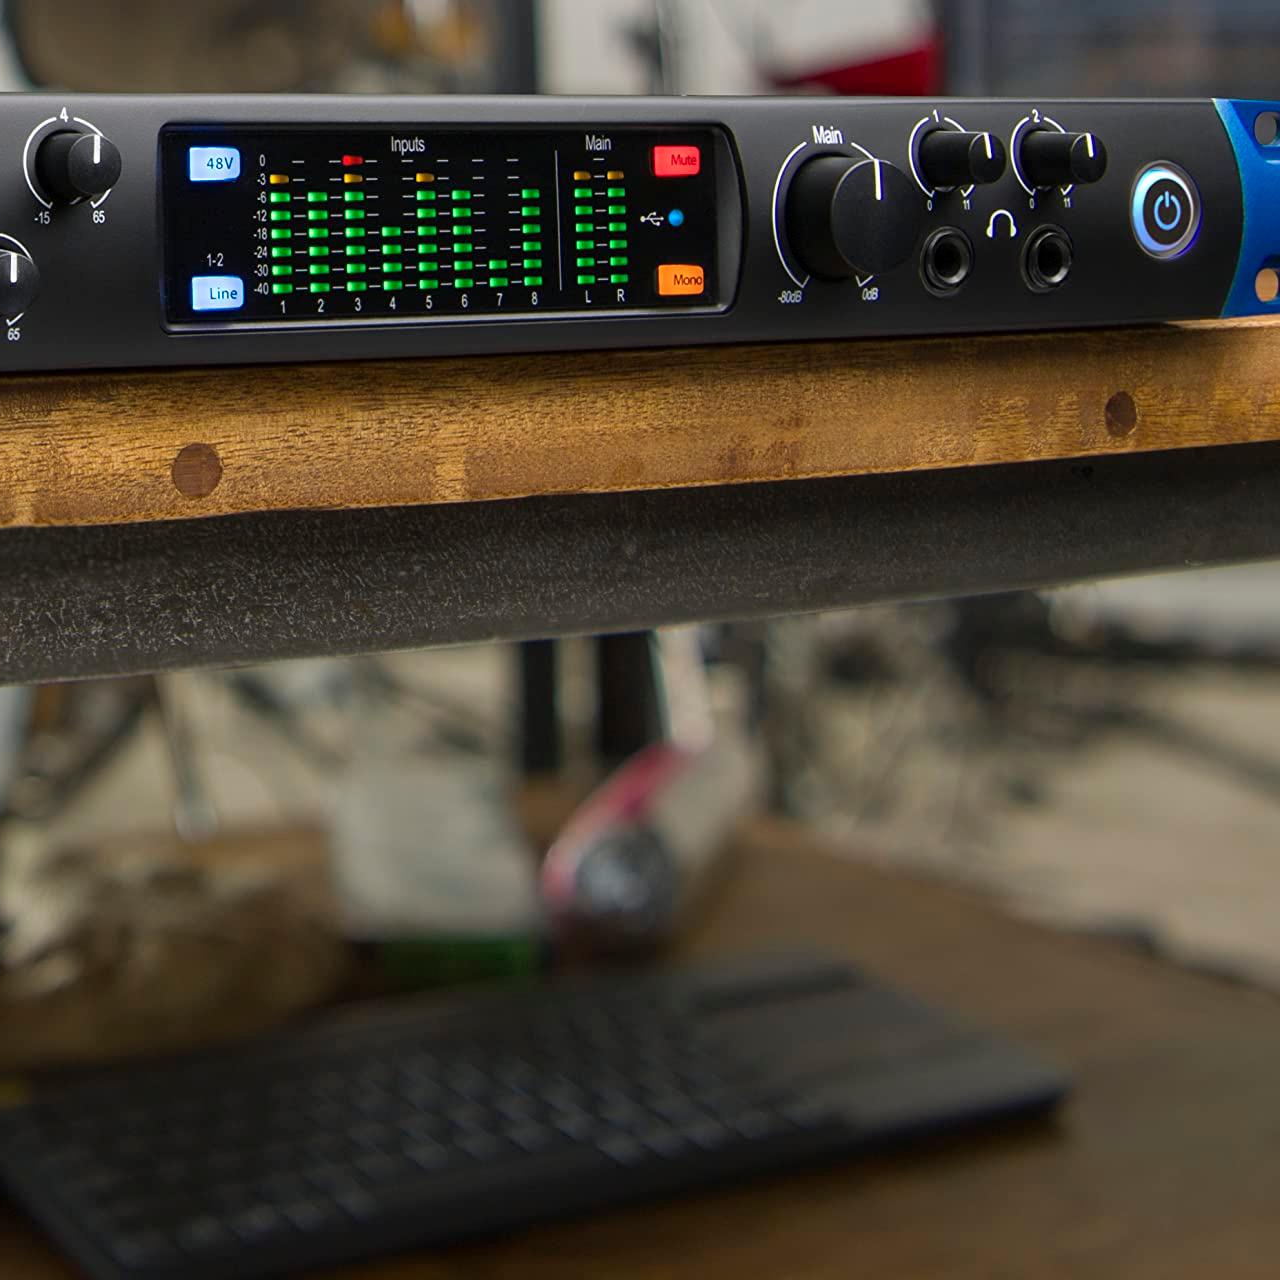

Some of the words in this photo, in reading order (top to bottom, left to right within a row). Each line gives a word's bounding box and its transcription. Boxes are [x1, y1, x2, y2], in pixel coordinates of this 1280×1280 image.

[60, 107, 68, 122] 4
[933, 110, 939, 122] 1
[1032, 109, 1040, 122] 2
[813, 126, 843, 144] Main
[391, 136, 426, 156] Inputs
[586, 135, 611, 151] Main
[206, 156, 234, 170] 48V
[260, 154, 265, 166] 0
[670, 153, 698, 167] Mute
[257, 173, 266, 185] -3
[257, 192, 266, 203] -6
[1030, 198, 1035, 208] 0
[1064, 198, 1071, 207] 11
[927, 200, 932, 211] 0
[963, 199, 970, 209] 11
[34, 211, 50, 224] -15
[93, 211, 105, 223] 65
[253, 210, 267, 221] -12
[254, 228, 267, 240] -18
[254, 246, 267, 258] -24
[207, 253, 223, 266] 1-2
[254, 264, 268, 276] -30
[673, 274, 703, 286] Mono
[209, 286, 239, 301] Line
[254, 283, 268, 295] -40
[862, 287, 879, 301] 0dB
[586, 290, 591, 303] L
[617, 289, 624, 301] R
[777, 290, 803, 304] -80dB
[281, 300, 285, 313] 1
[318, 299, 324, 312] 2
[355, 298, 361, 311] 3
[390, 297, 395, 309] 4
[426, 295, 432, 309] 5
[462, 294, 468, 307] 6
[497, 293, 502, 305] 7
[532, 292, 538, 305] 8
[8, 328, 20, 340] 65
